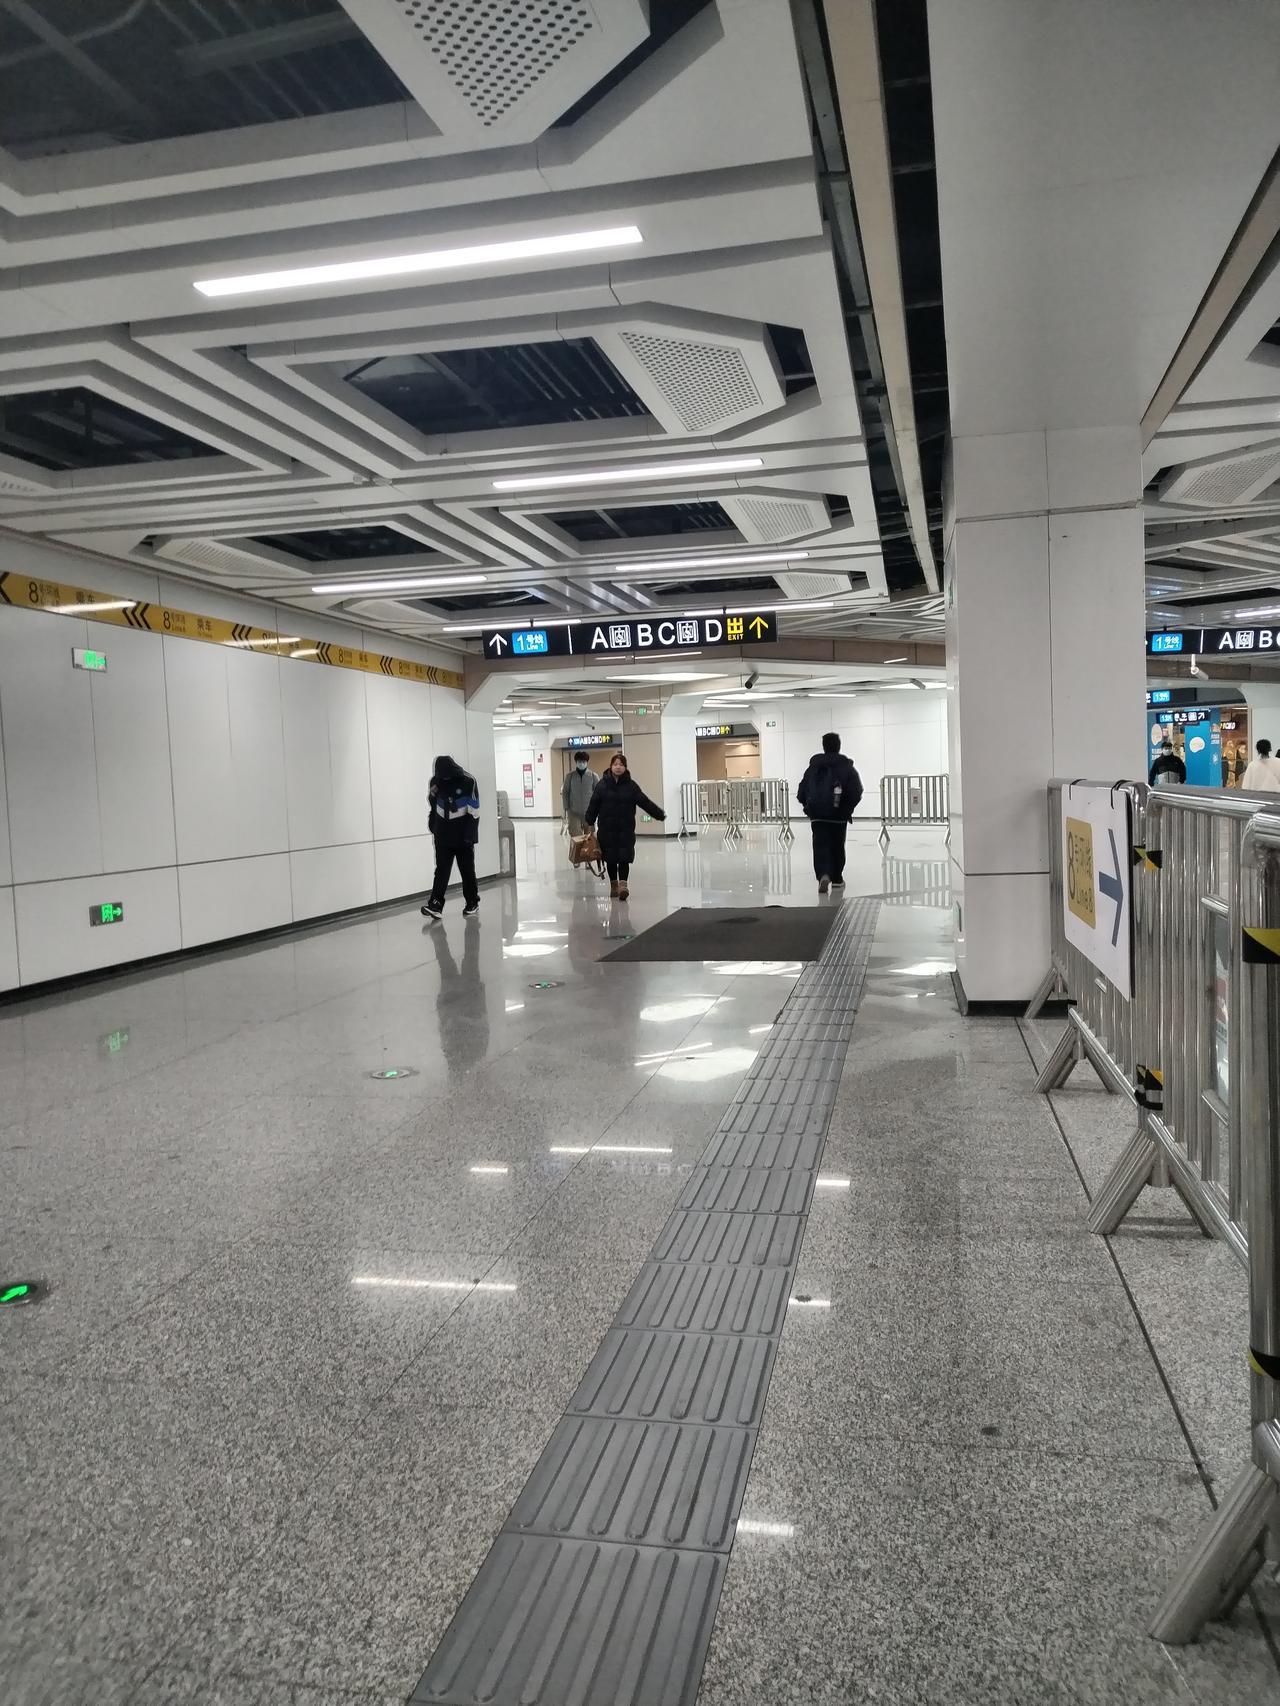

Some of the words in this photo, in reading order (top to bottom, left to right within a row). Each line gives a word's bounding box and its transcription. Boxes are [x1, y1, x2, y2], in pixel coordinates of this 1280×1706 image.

[591, 626, 609, 650] A
[637, 623, 654, 647] B
[658, 622, 676, 645] C
[705, 619, 723, 642] D
[1218, 631, 1235, 650] A
[1259, 630, 1273, 648] B
